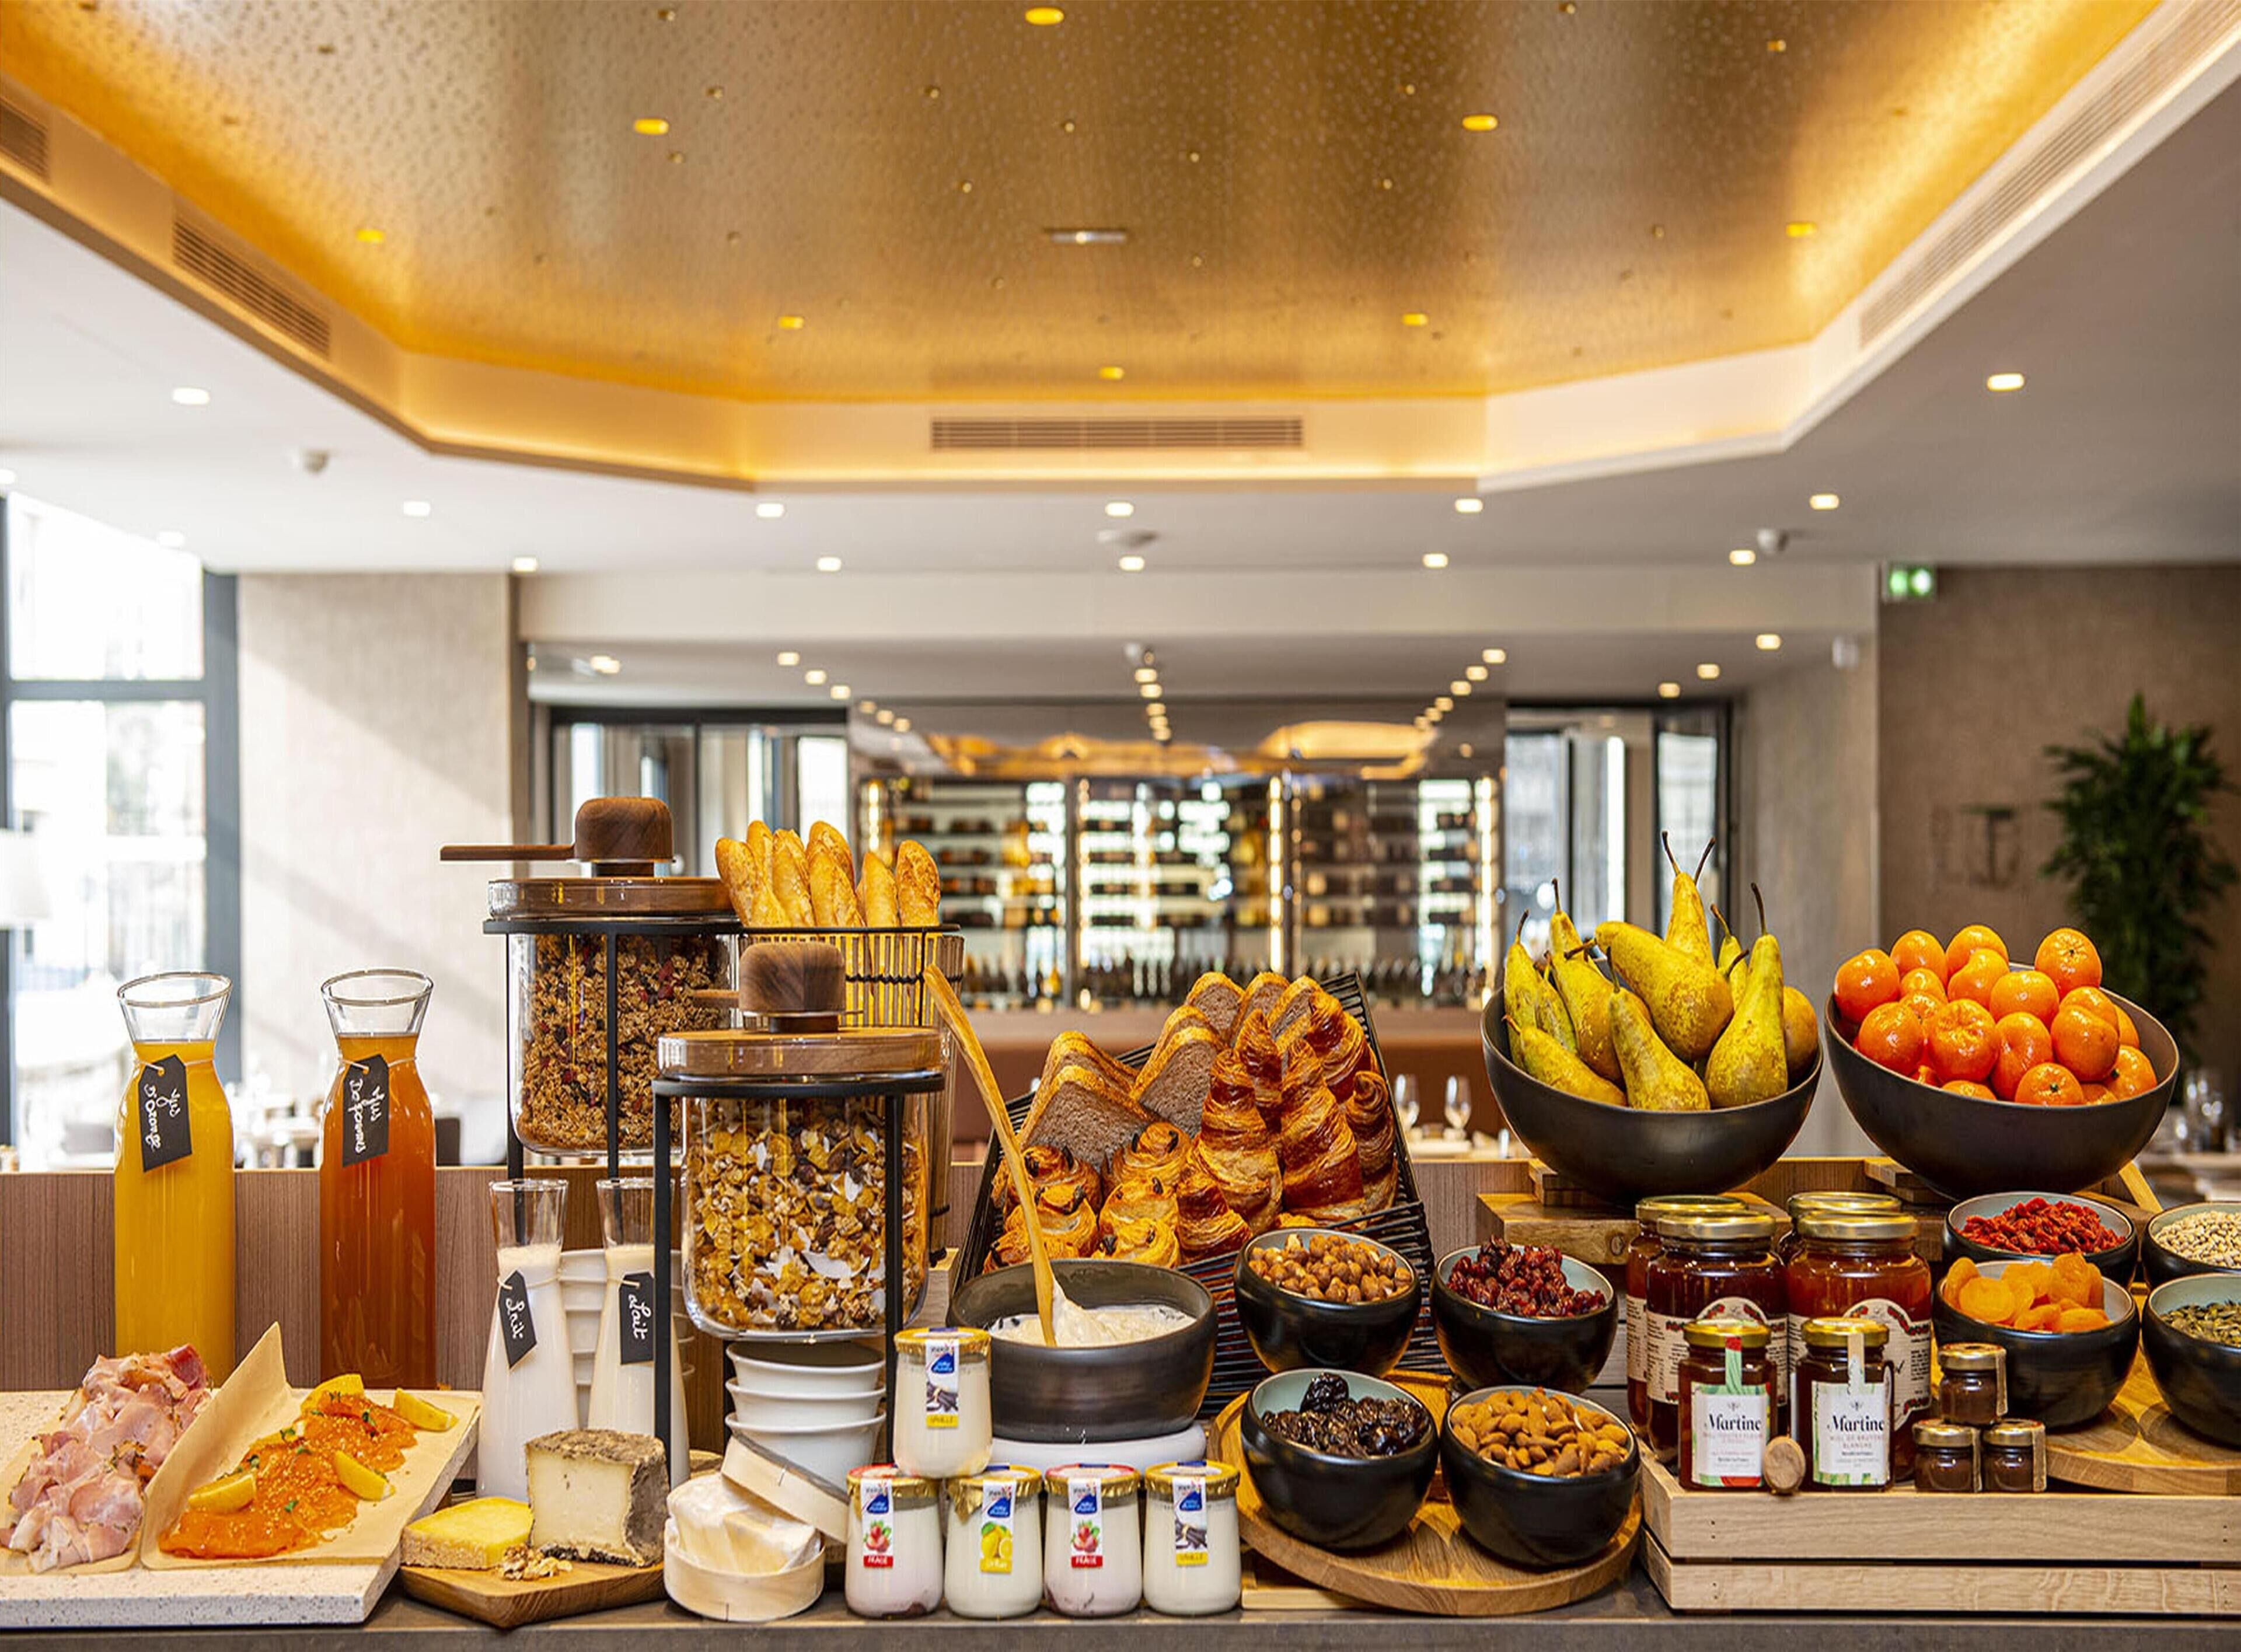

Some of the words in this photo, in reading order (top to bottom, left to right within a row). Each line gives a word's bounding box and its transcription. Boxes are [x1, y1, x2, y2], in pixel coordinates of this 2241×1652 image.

[156, 1088, 181, 1117] Jus
[361, 1085, 385, 1122] Jus
[505, 1298, 525, 1339] Lait
[628, 1294, 652, 1340] Lait
[1704, 1413, 1762, 1431] Martine
[1827, 1414, 1885, 1433] Martine
